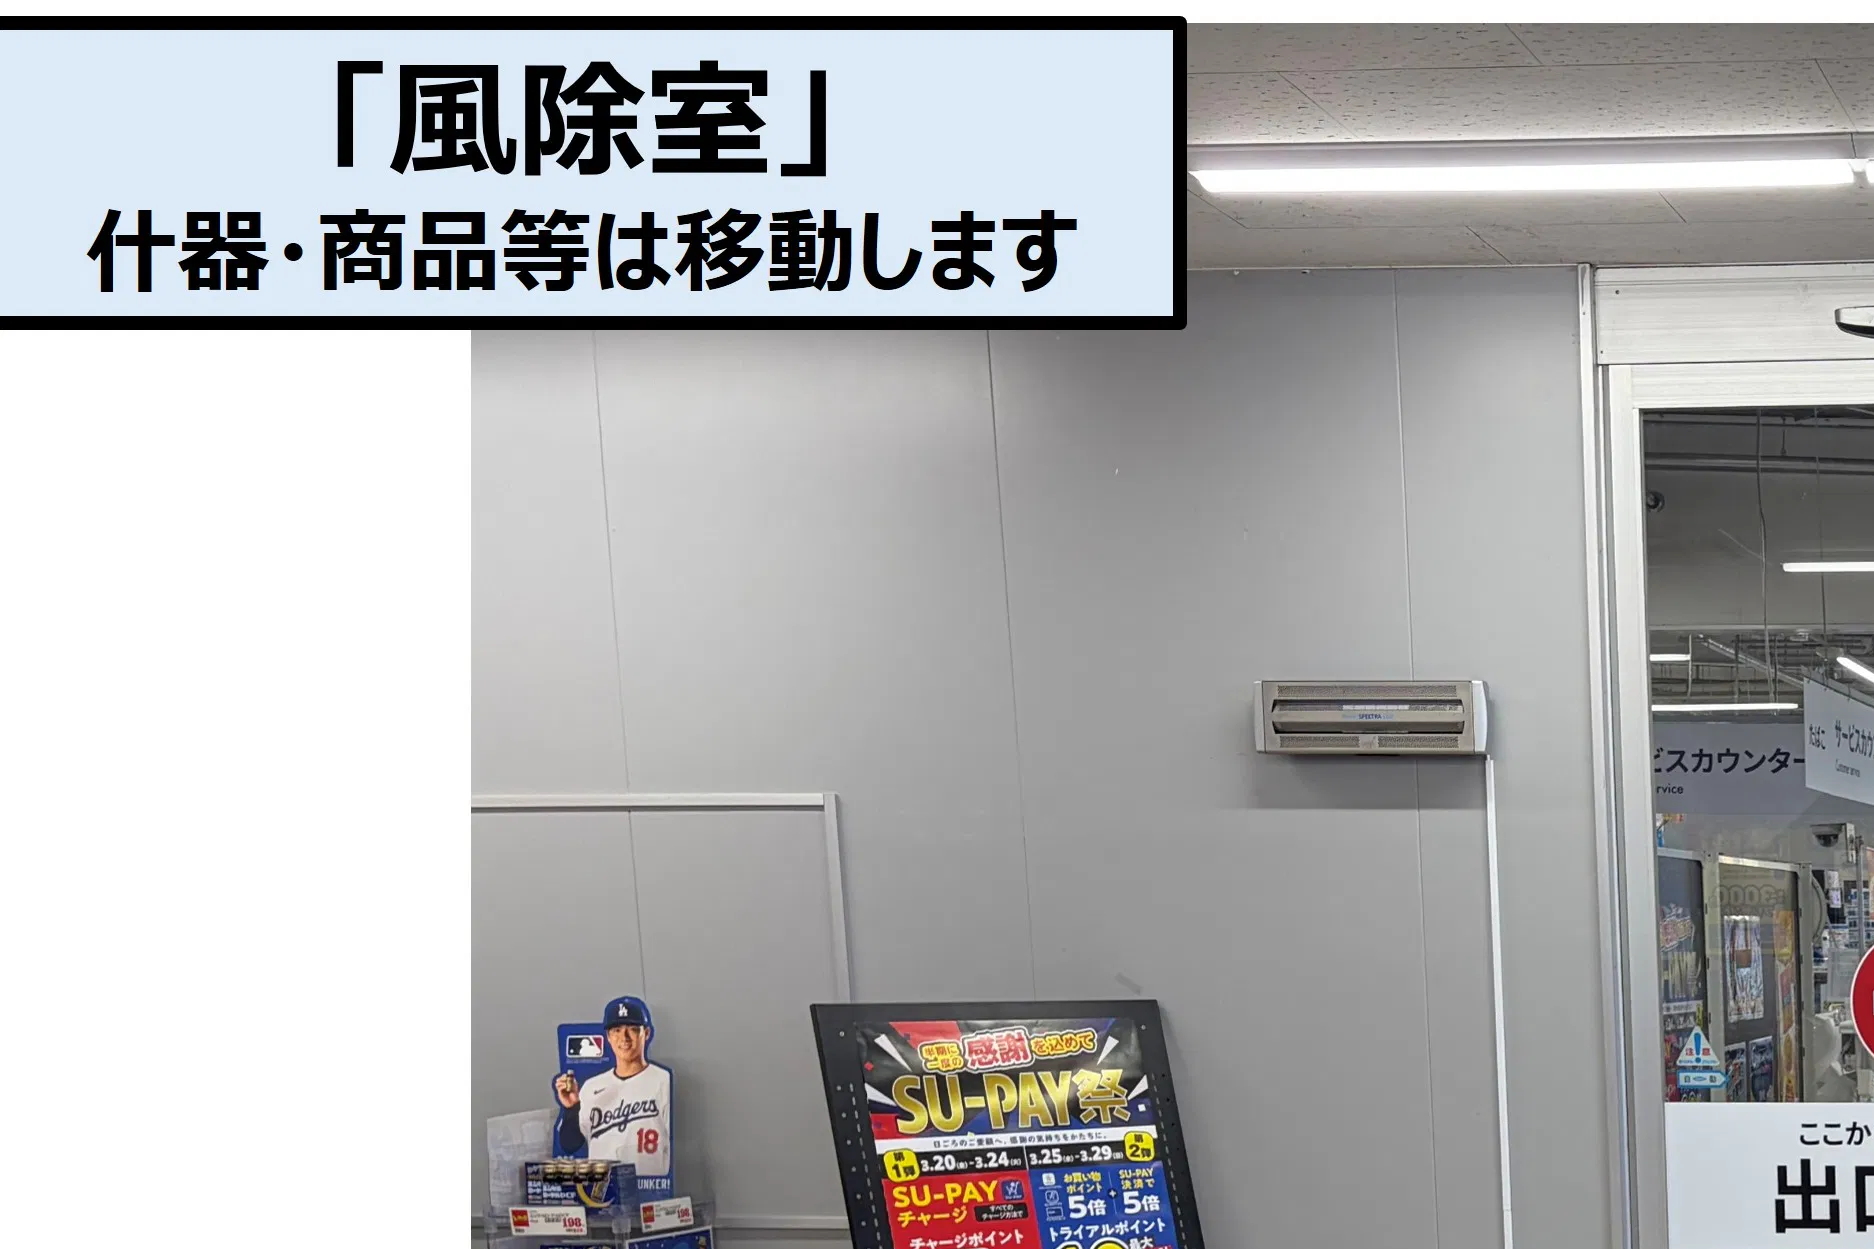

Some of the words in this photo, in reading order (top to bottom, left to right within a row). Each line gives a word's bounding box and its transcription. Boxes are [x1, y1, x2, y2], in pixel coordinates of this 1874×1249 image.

[1809, 724, 1826, 750] たばこ
[964, 1031, 1030, 1068] 感謝
[1032, 1032, 1094, 1056] を込めて
[926, 1056, 963, 1070] 一度の
[892, 1068, 1131, 1135] SU-PAY祭
[589, 1098, 660, 1132] Dodgers
[636, 1128, 659, 1154] 18
[1063, 1171, 1102, 1184] お買い物
[1119, 1168, 1154, 1180] SU-PAY
[1121, 1178, 1155, 1190] 決済で
[892, 1180, 998, 1208] SU-PAY
[1066, 1182, 1103, 1195] ポイント
[1068, 1194, 1107, 1219] 5倍
[1123, 1190, 1161, 1215] 5倍
[562, 1217, 582, 1228] 198
[897, 1206, 968, 1228] チャージ
[1050, 1217, 1166, 1242] トライアルポイント
